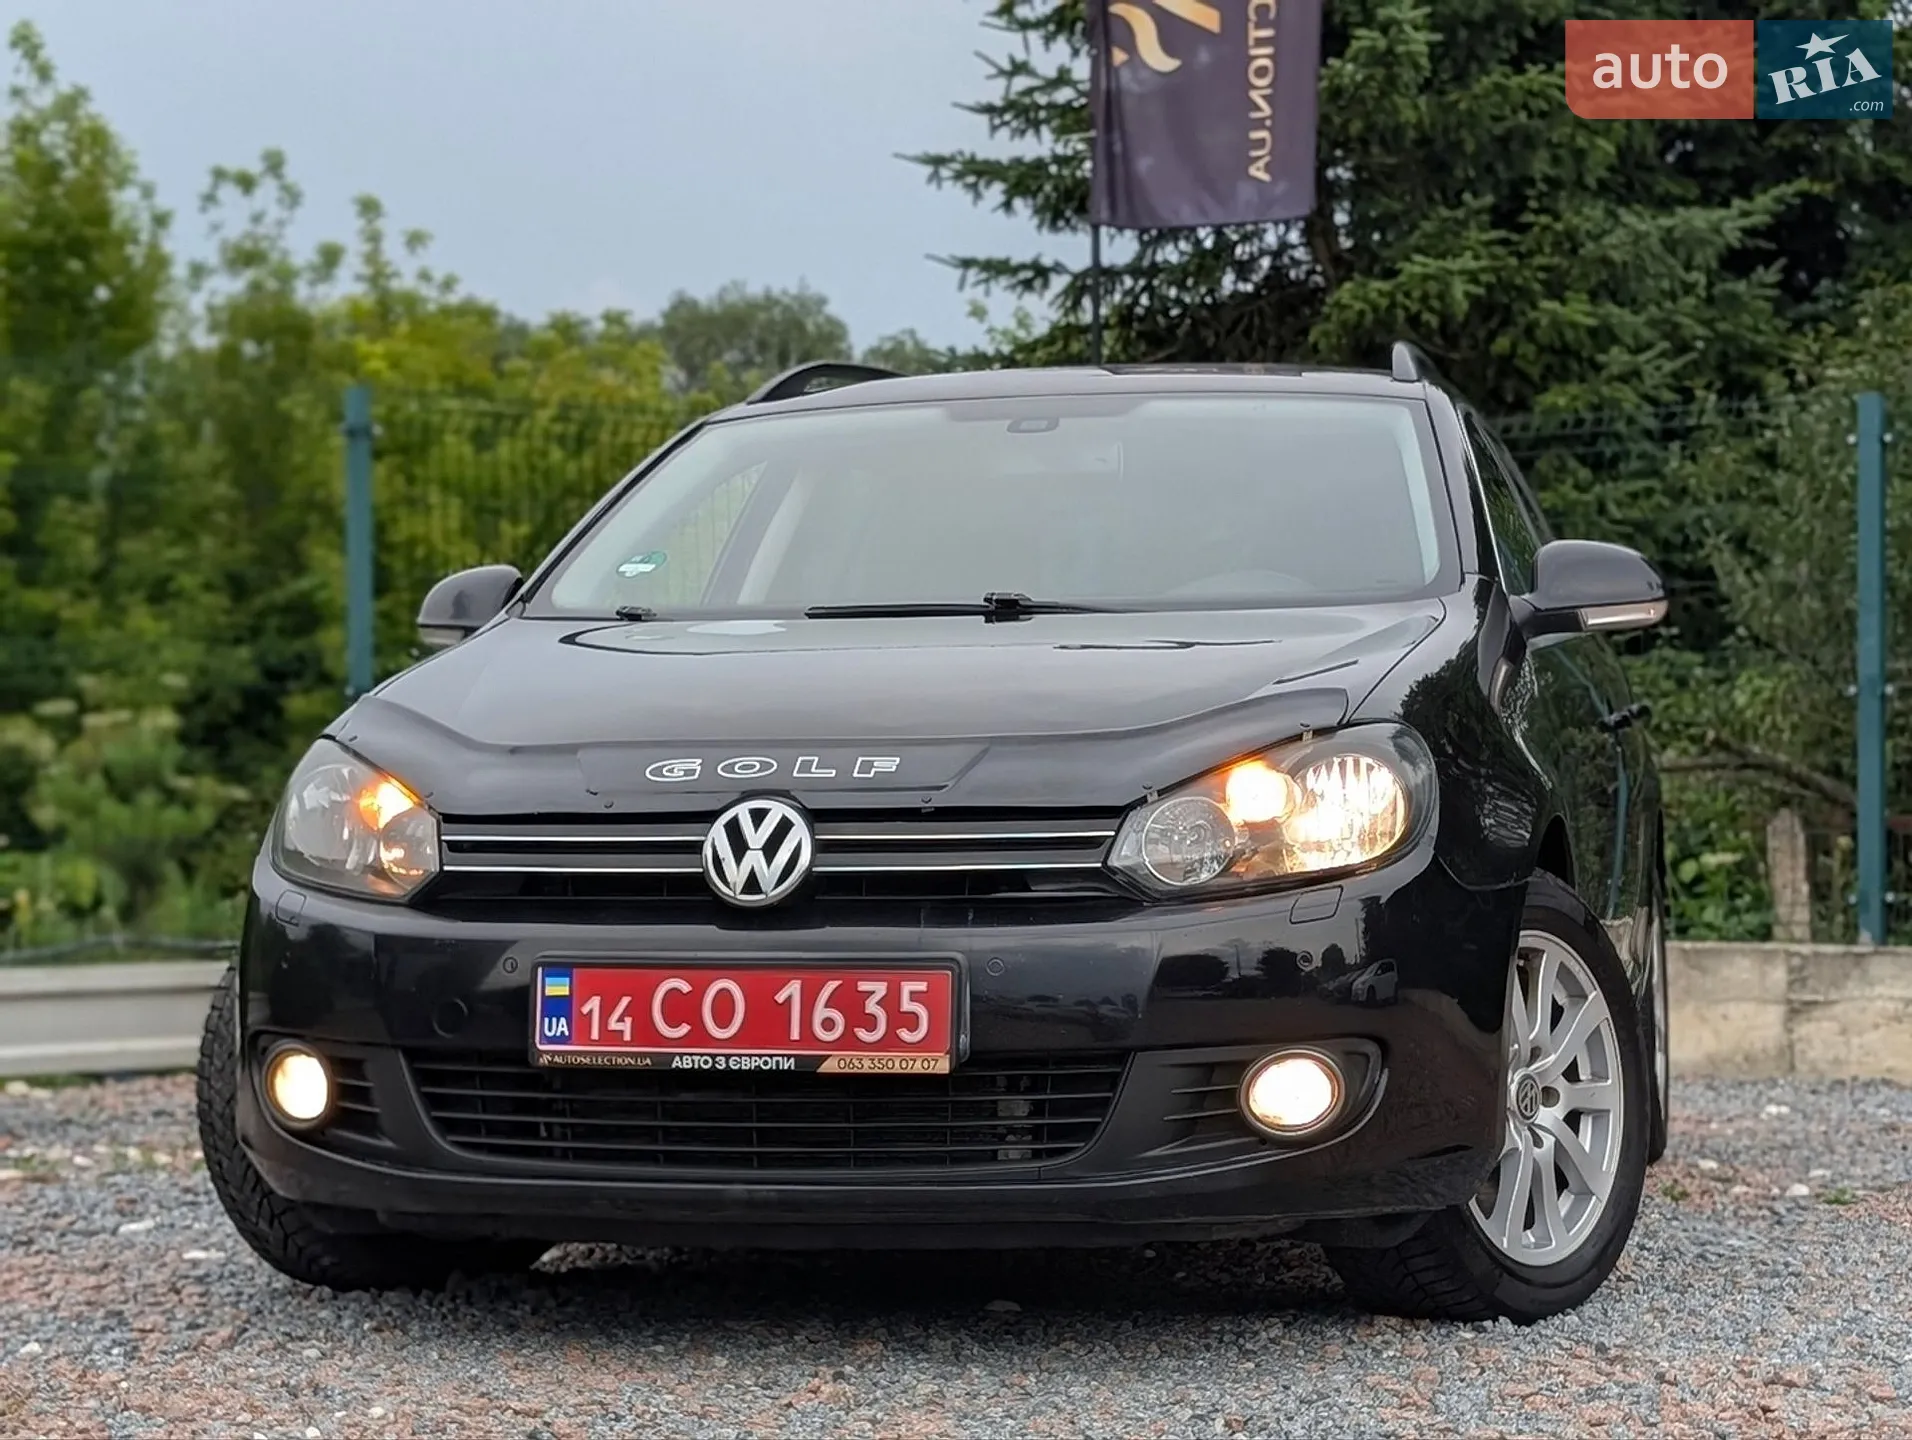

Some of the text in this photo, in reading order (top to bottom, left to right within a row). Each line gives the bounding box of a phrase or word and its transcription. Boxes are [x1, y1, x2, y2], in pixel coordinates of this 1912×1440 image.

[645, 756, 900, 782] GOLF
[703, 799, 812, 905] VW
[580, 977, 931, 1044] 14 CO 1635
[543, 1016, 569, 1037] UA
[552, 1052, 652, 1067] AUTOSELECTION.UA
[670, 1055, 713, 1070] АВТО
[728, 1056, 796, 1071] ЄВРОПИ
[836, 1058, 940, 1071] 063 350 07 07
